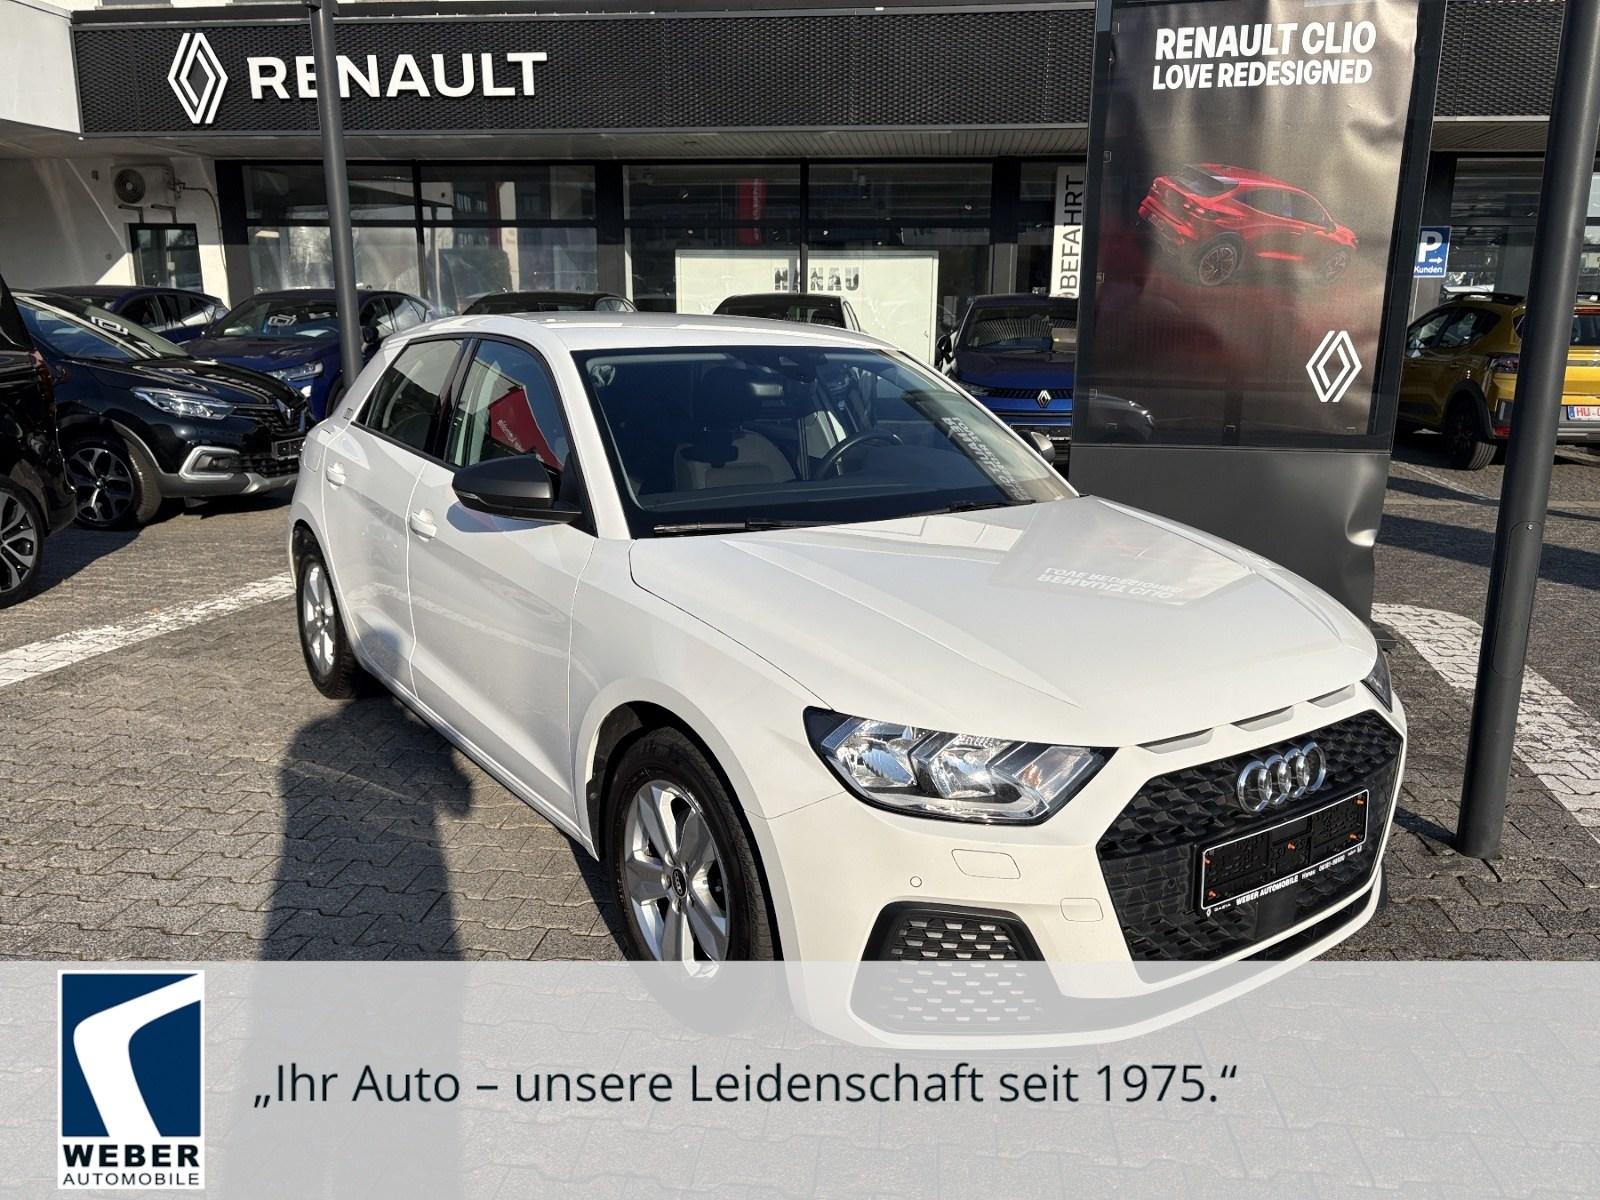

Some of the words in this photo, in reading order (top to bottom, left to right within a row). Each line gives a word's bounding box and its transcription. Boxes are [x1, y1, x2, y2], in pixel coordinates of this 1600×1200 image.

[1155, 23, 1298, 60] RENAULT
[1302, 20, 1377, 55] CLIO
[246, 51, 548, 100] RENAULT
[1152, 63, 1214, 90] LOVE
[1217, 59, 1373, 88] REDESIGNED
[1418, 230, 1443, 263] P
[1413, 265, 1443, 274] Kunden
[1236, 890, 1259, 906] WEBER
[1260, 875, 1299, 896] AUTOMOBILE
